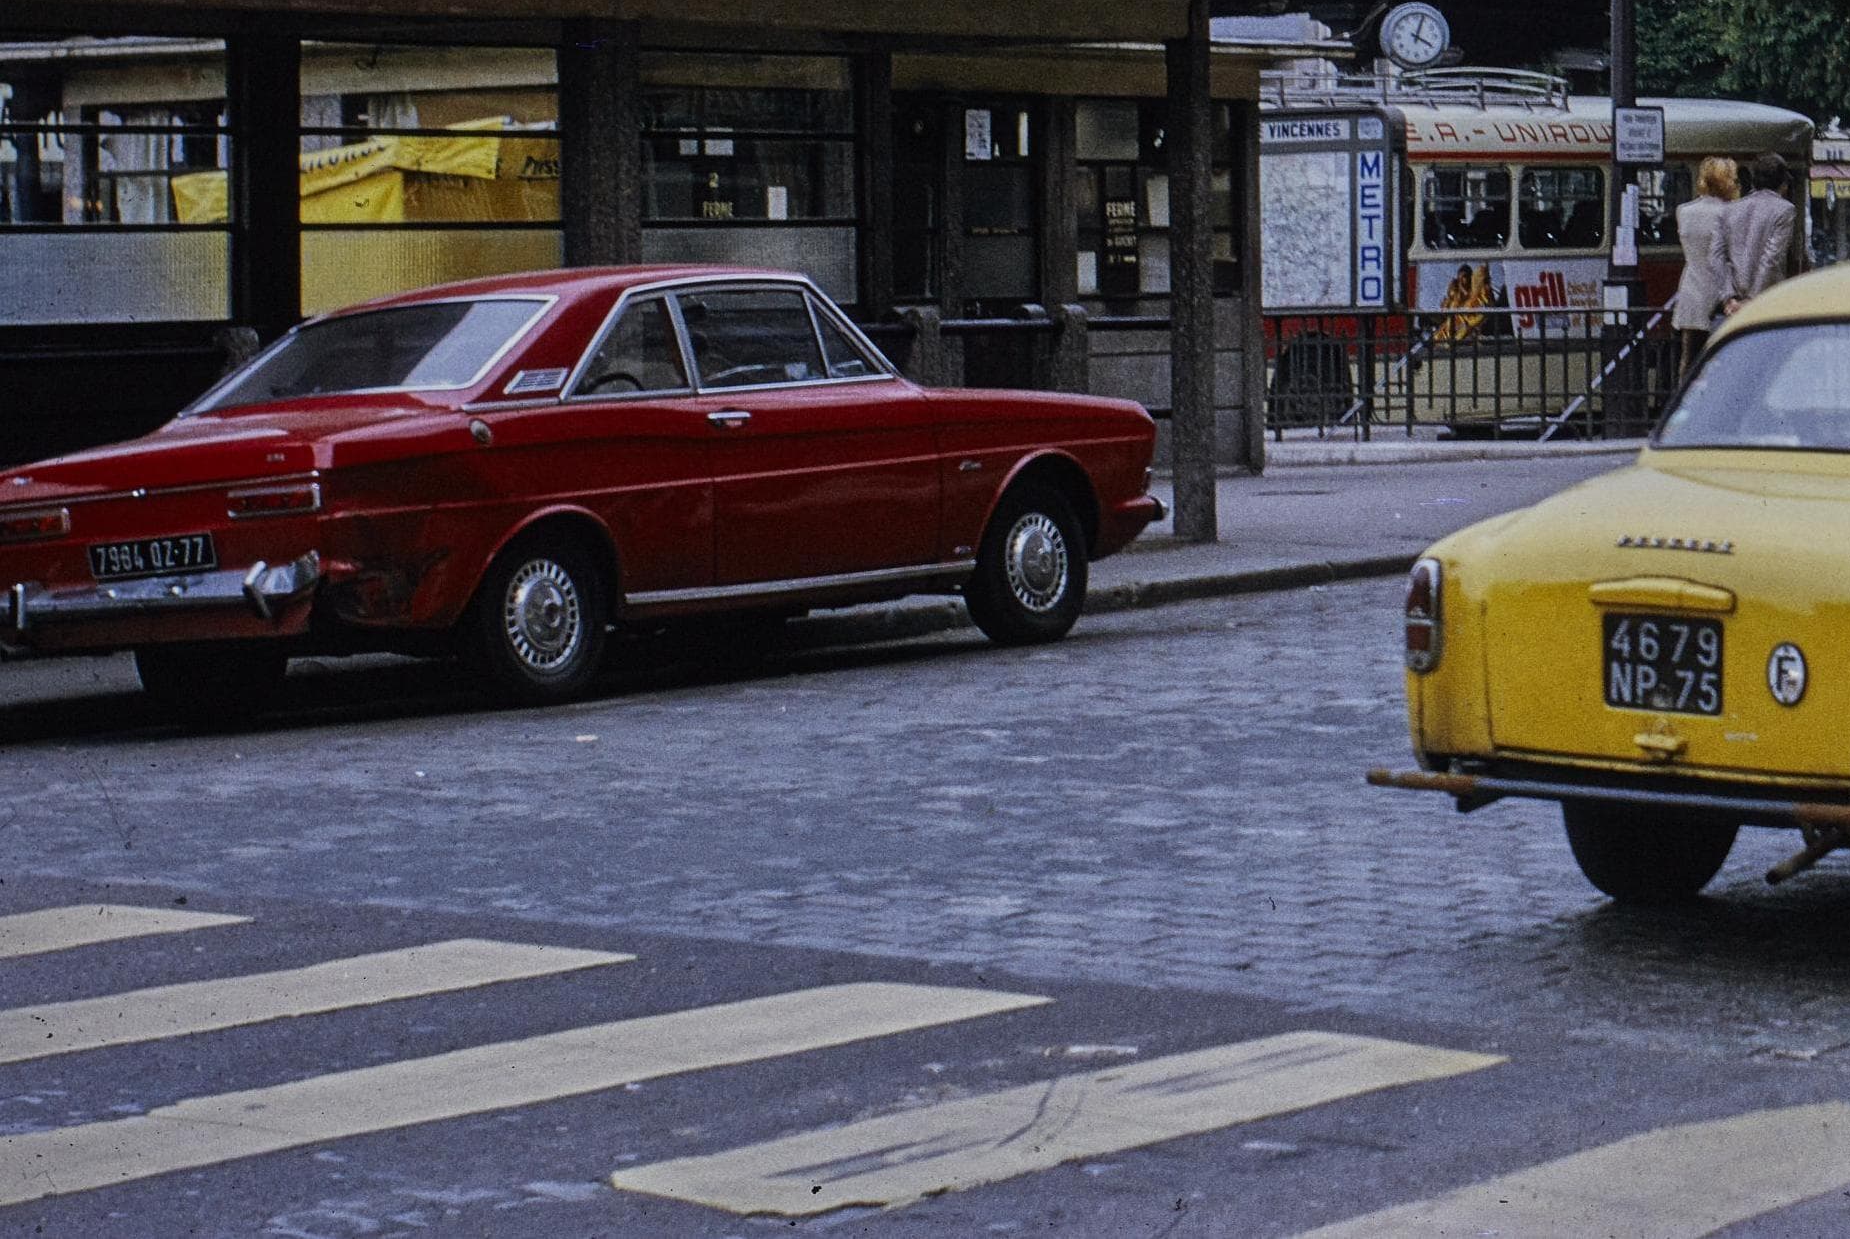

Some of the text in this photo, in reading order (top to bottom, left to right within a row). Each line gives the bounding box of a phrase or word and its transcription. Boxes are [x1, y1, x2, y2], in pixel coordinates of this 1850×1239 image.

[1269, 122, 1341, 139] VINCENNES
[1360, 153, 1382, 301] METRO
[1610, 619, 1719, 667] 4679
[1610, 662, 1719, 713] NP 75
